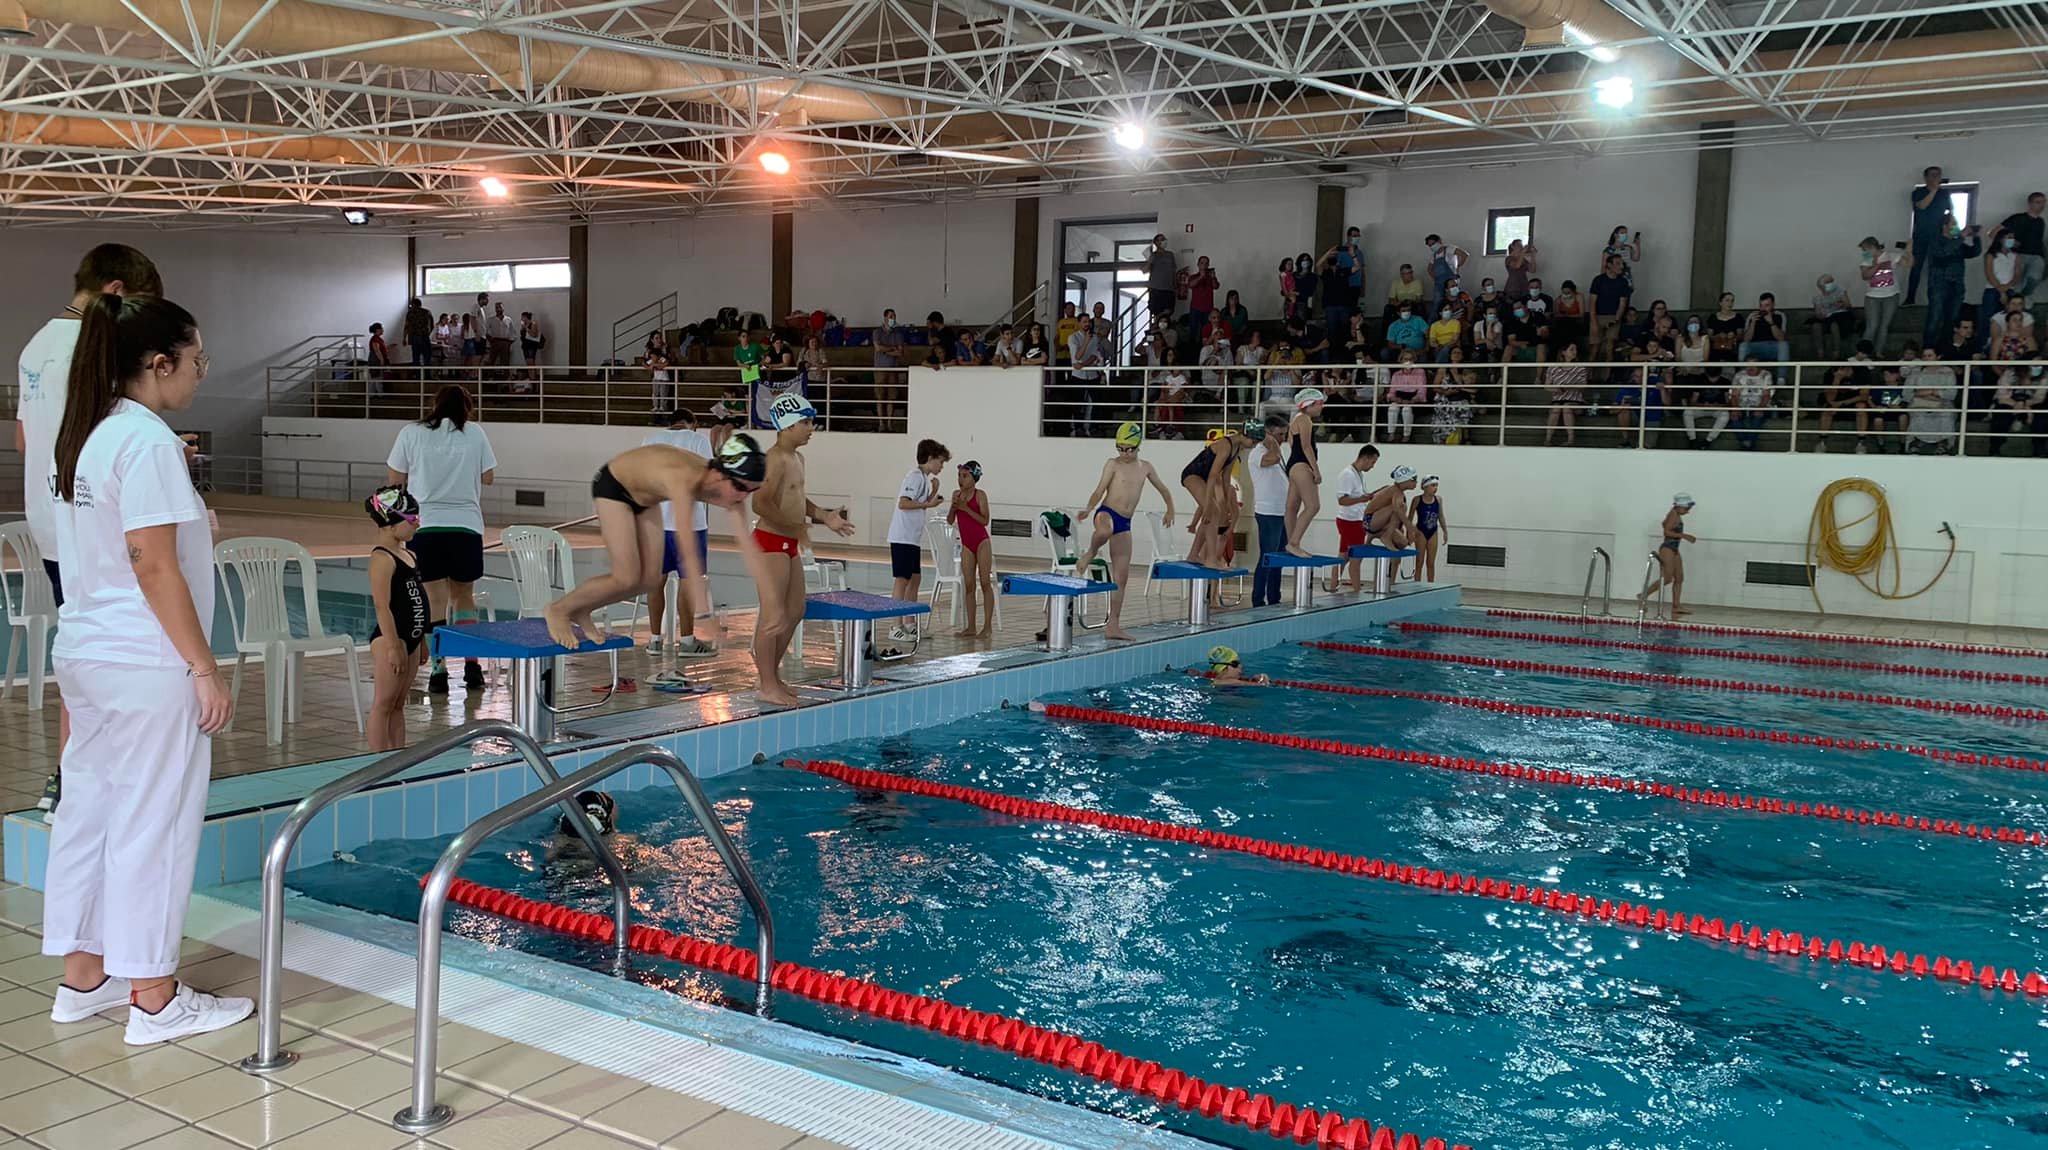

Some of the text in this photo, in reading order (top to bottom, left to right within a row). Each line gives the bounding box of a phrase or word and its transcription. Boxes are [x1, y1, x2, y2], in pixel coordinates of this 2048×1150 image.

[772, 397, 801, 420] ISEU
[1003, 578, 1011, 593] 3
[406, 580, 425, 639] ESPINHO
[434, 633, 441, 654] 1
[541, 668, 551, 706] 1
